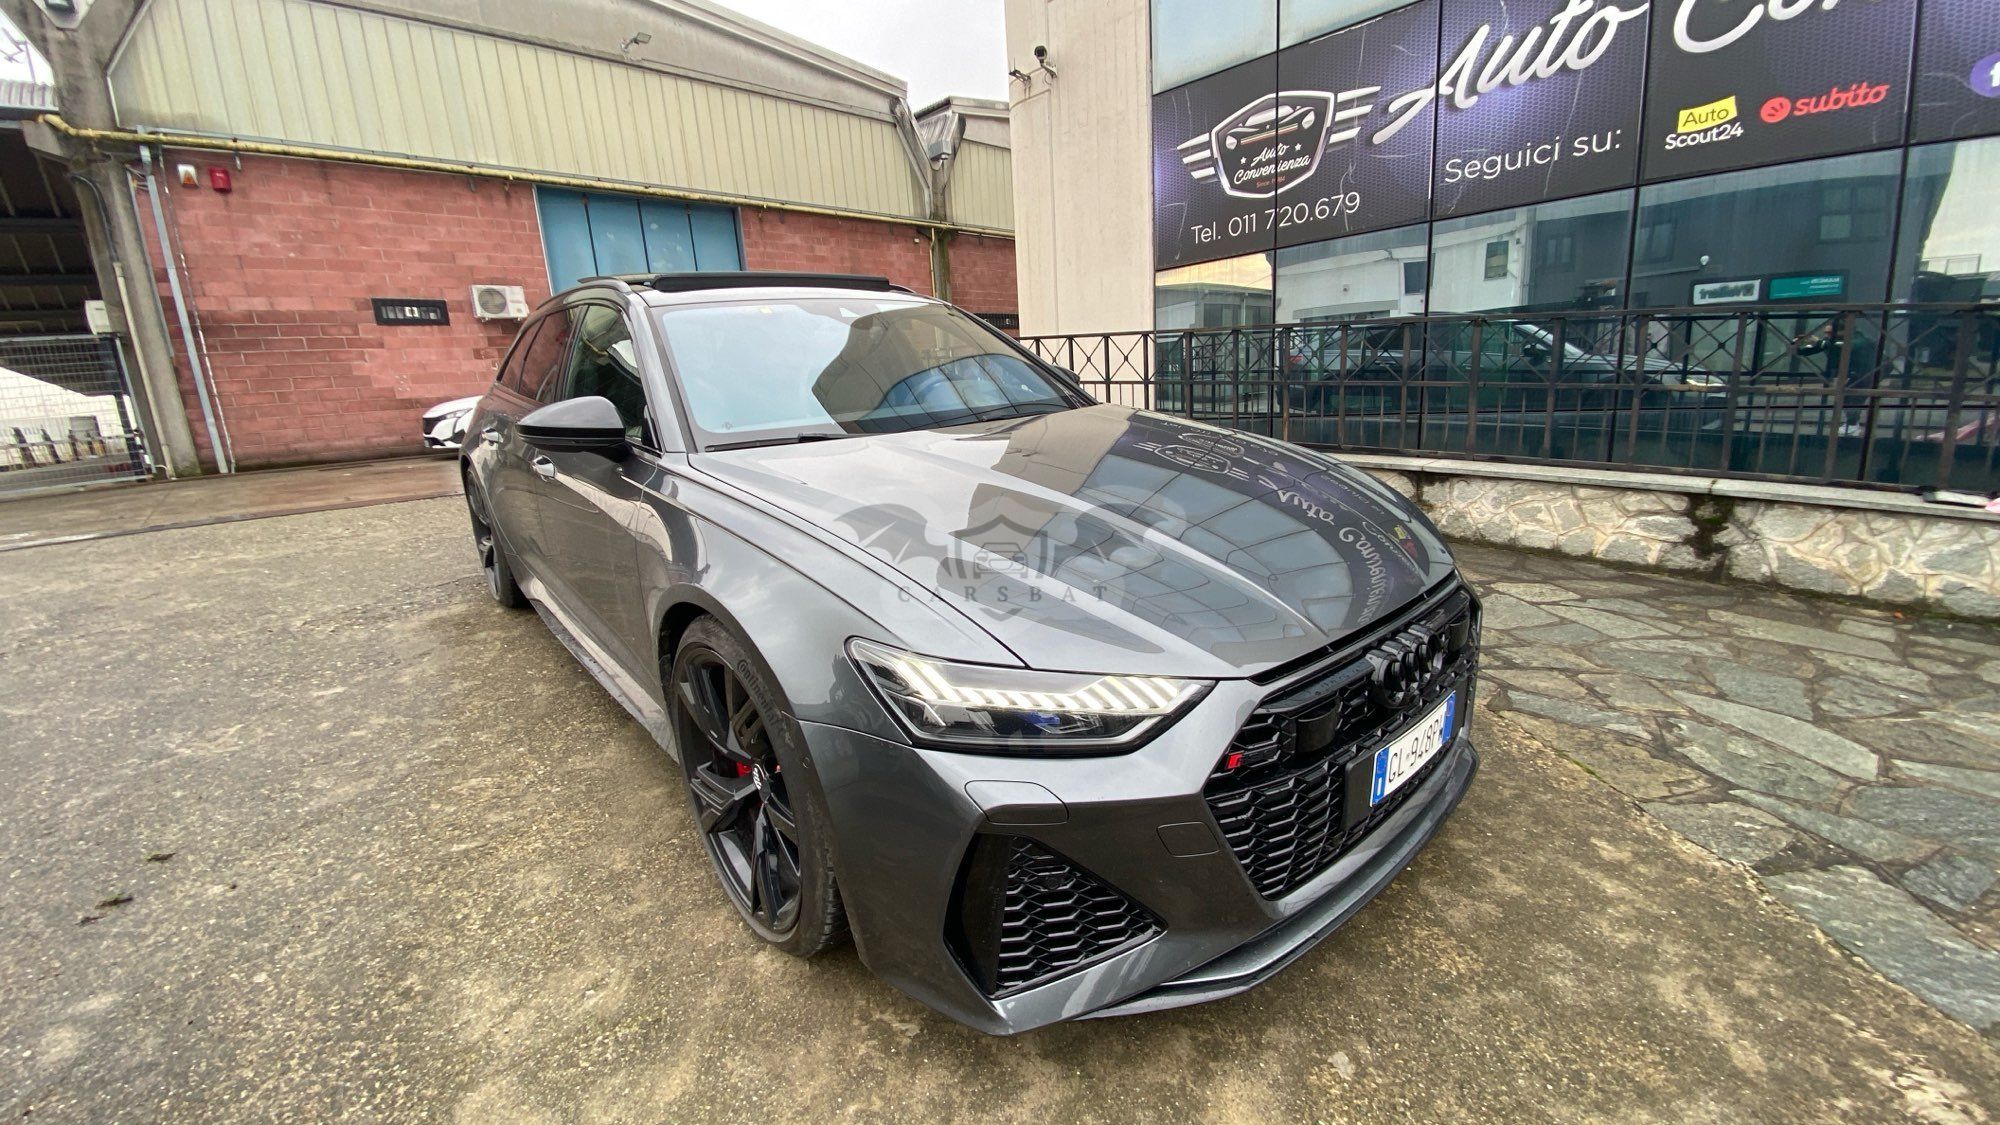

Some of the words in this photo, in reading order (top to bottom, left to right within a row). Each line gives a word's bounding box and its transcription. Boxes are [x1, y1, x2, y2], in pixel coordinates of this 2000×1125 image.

[1372, 0, 1649, 144] Auto
[1793, 81, 1890, 116] subito
[1682, 106, 1730, 127] Auto
[1664, 121, 1744, 149] Scout24
[1233, 154, 1311, 184] Convenienza
[1250, 143, 1290, 166] Auto
[1444, 135, 1560, 183] Seguici
[1572, 129, 1621, 156] su:
[1190, 221, 1222, 244] Tel.
[1228, 213, 1256, 237] 011
[1264, 191, 1361, 230] 720.679
